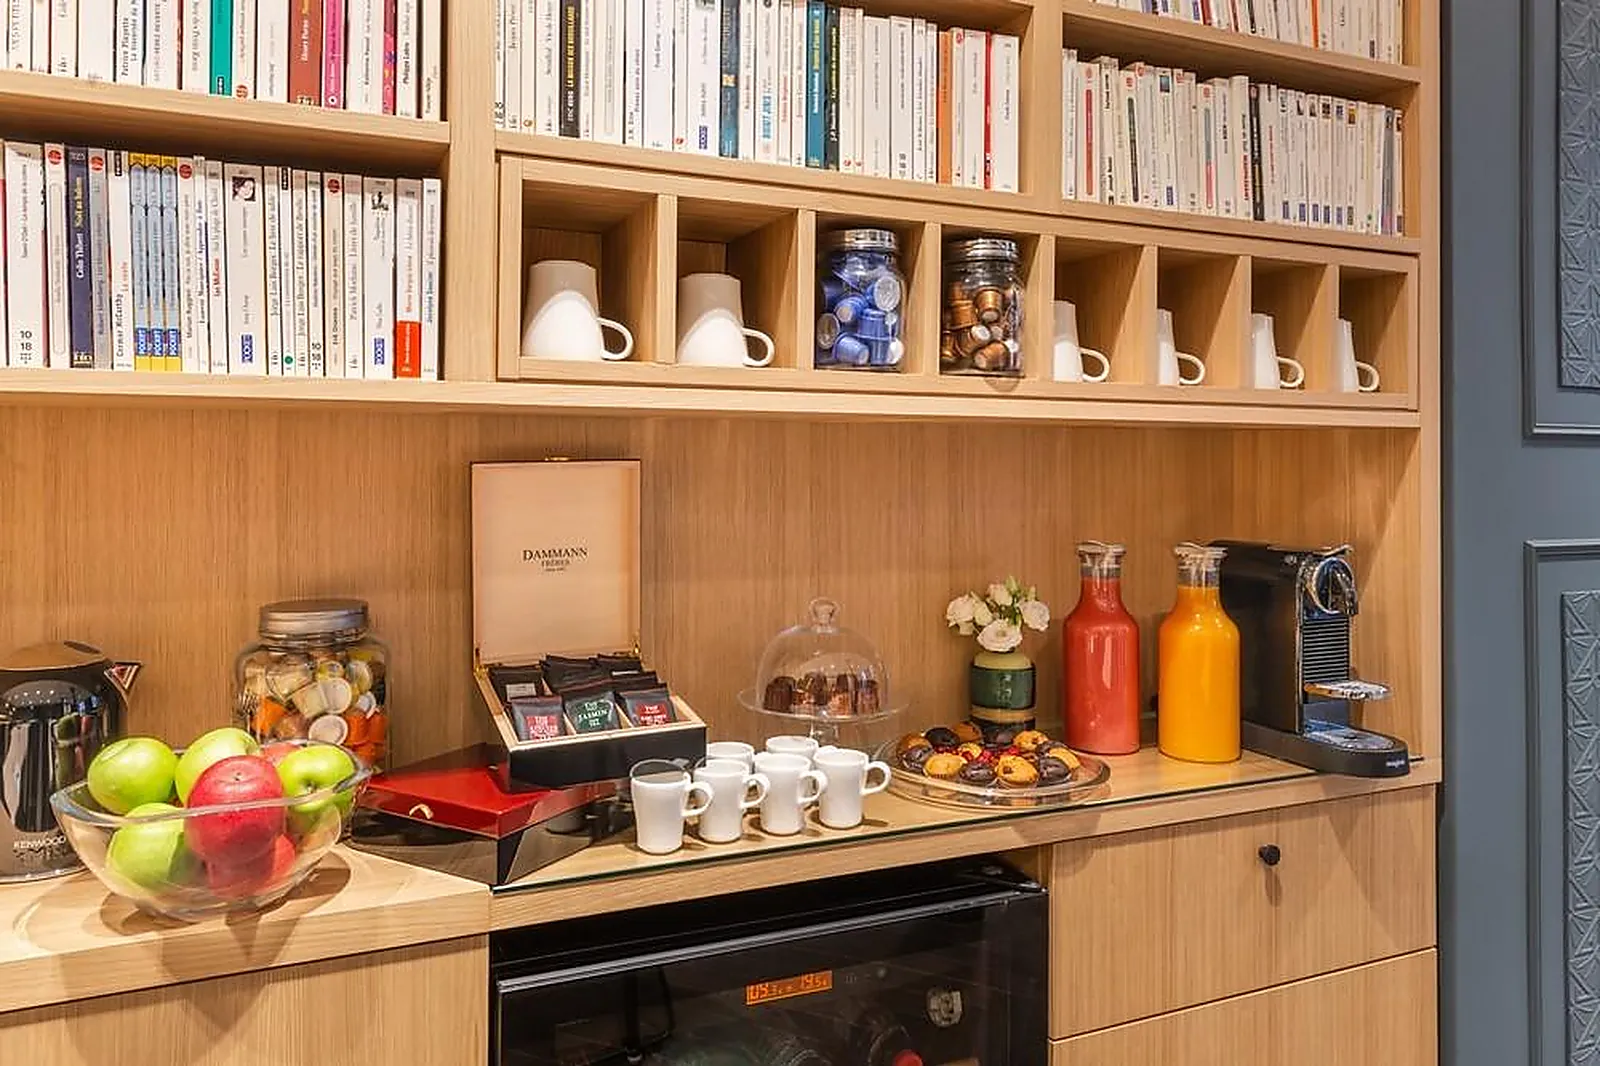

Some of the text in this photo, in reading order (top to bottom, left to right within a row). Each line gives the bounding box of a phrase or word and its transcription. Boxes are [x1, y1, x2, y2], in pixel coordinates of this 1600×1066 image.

[114, 294, 124, 357] Cormac McCarthy
[20, 330, 32, 339] 10
[20, 342, 33, 351] 18
[523, 548, 588, 561] DAMMANN
[14, 836, 67, 850] KENWOOD
